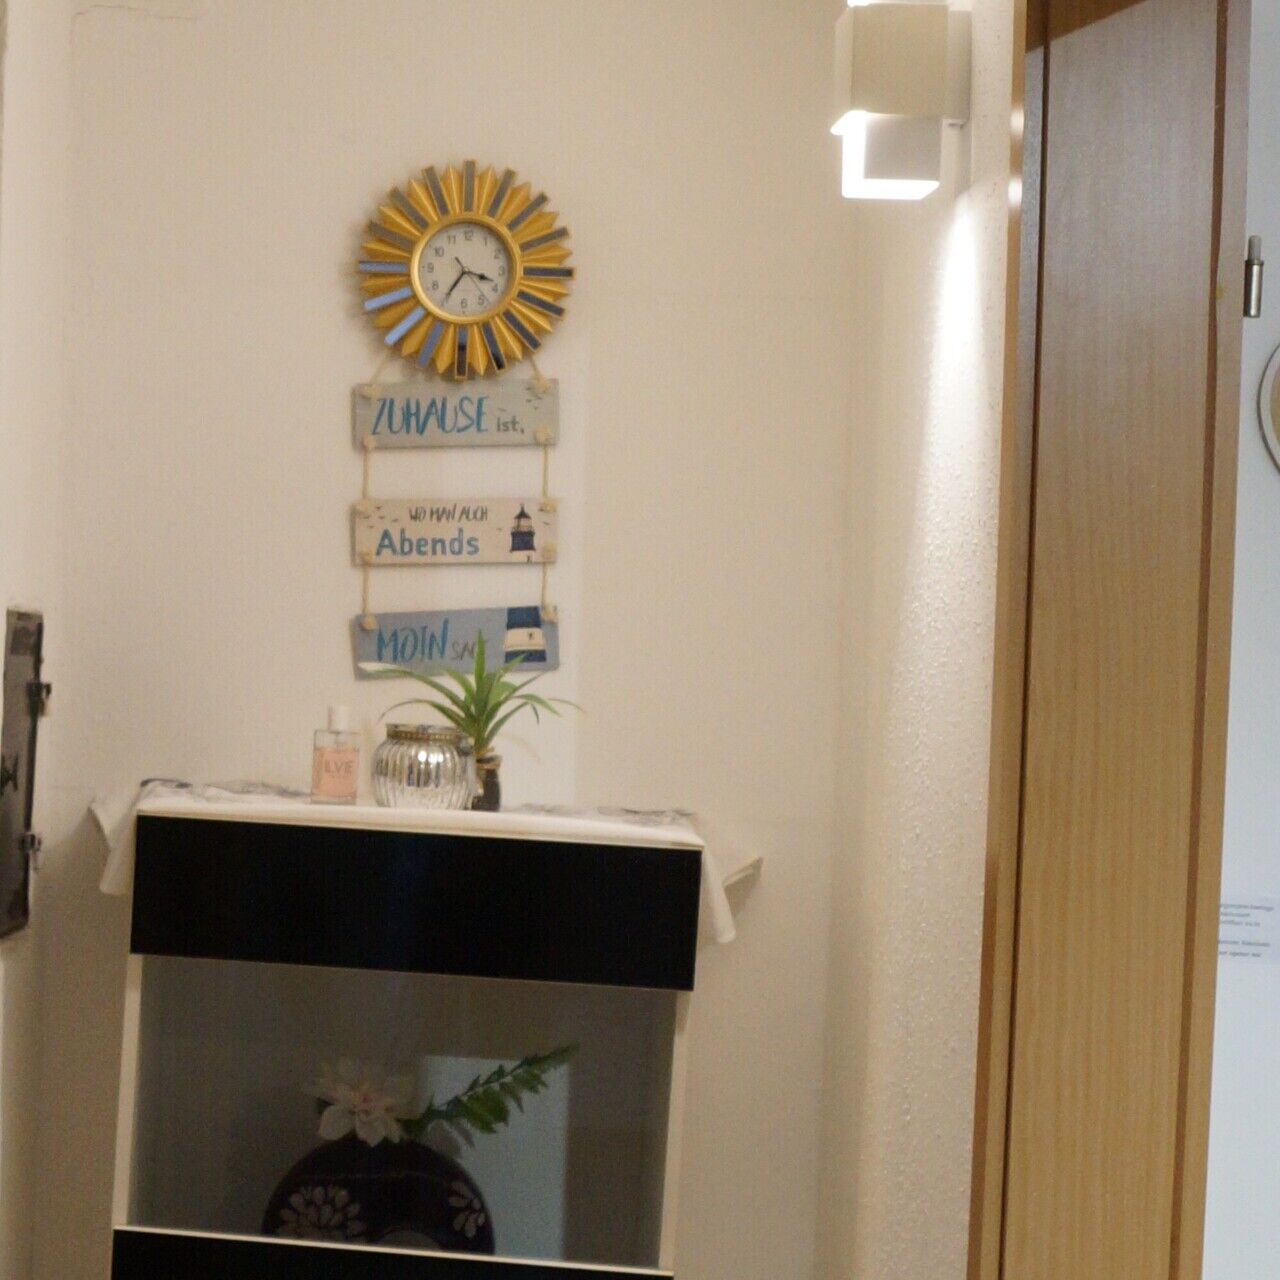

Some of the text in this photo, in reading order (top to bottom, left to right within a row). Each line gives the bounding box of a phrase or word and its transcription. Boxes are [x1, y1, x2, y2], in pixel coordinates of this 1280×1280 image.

[371, 396, 490, 436] ZUHAUSE
[457, 505, 488, 523] AUCH
[376, 527, 480, 556] Abends
[376, 617, 450, 663] MOIN
